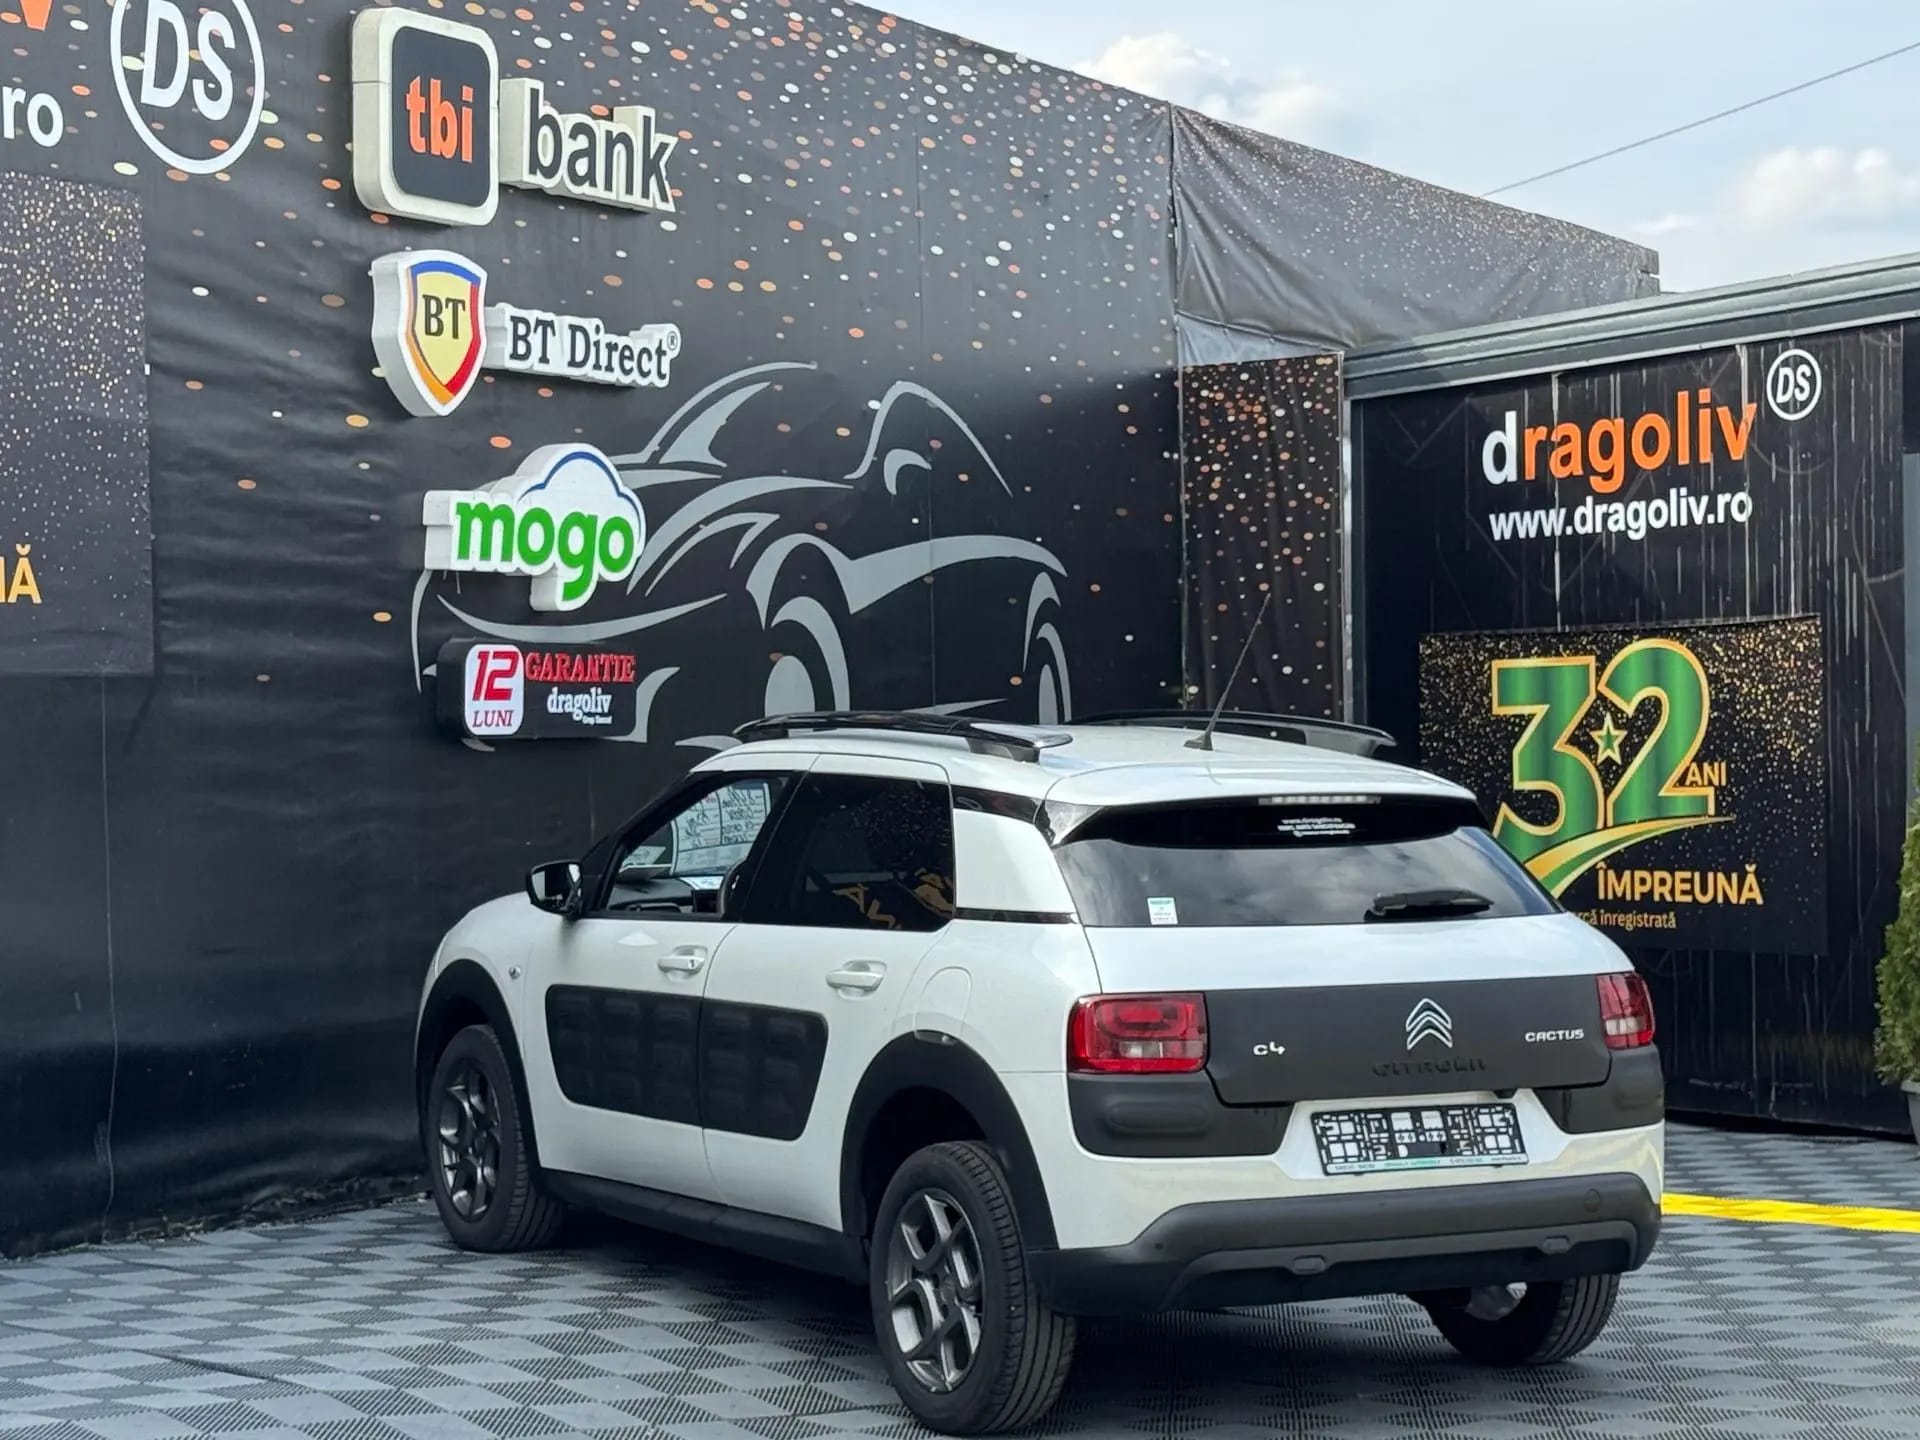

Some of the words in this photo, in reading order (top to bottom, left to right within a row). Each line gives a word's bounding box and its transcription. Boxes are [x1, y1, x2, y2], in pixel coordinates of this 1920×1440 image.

[406, 78, 474, 163] tbi
[529, 88, 675, 207] bank
[423, 295, 466, 340] BT
[509, 314, 555, 366] BT
[1776, 364, 1811, 404] DS
[1482, 388, 1757, 494] dragoliv
[1489, 487, 1753, 541] www.dragoliv.ro
[455, 500, 634, 602] mogo
[472, 650, 519, 702] 12
[525, 653, 635, 683] GARANTIE
[472, 709, 514, 729] LUNI
[547, 686, 612, 722] dragoliv
[1491, 638, 1716, 864] 32
[1684, 761, 1728, 787] ANI
[1597, 861, 1764, 906] ÎMPREUNĂ
[1525, 1028, 1585, 1043] CACTUS
